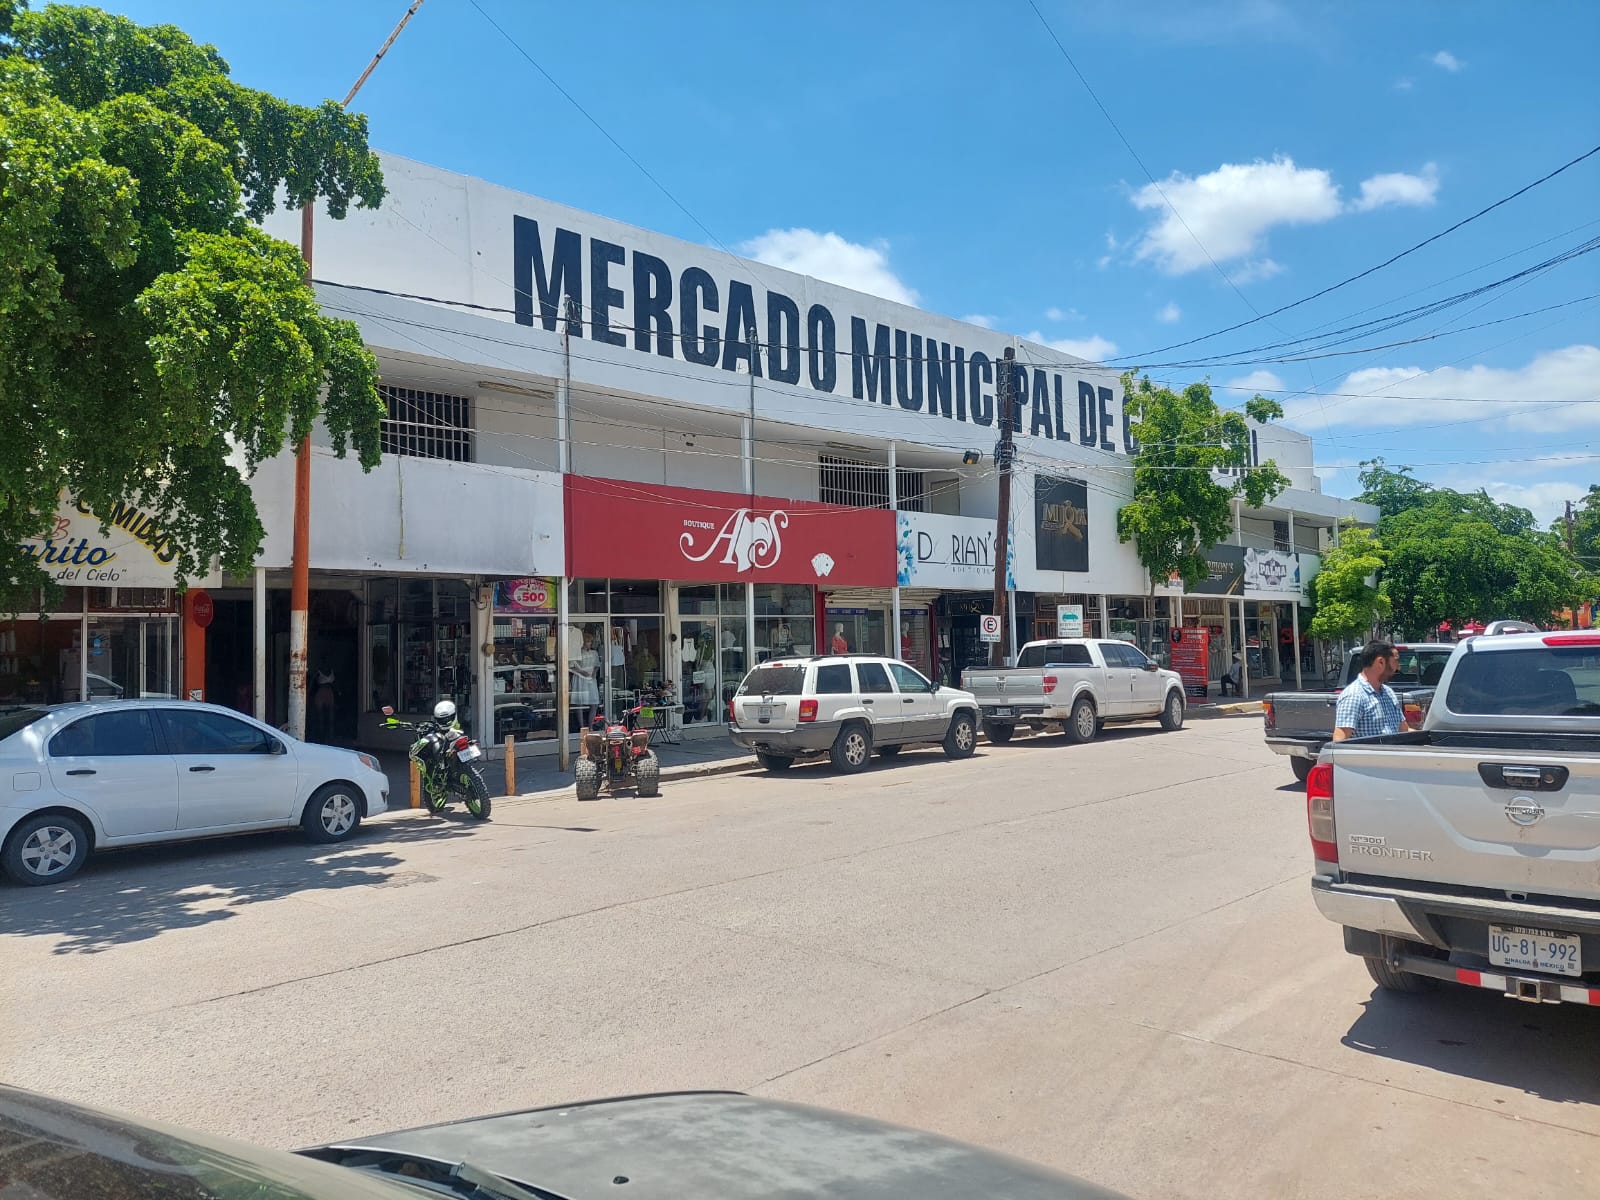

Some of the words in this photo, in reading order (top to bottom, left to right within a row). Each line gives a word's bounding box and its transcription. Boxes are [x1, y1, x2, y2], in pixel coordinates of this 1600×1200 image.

[514, 215, 836, 393] MERCADO
[851, 315, 1070, 442] MUNICIPAL
[1078, 379, 1116, 452] DE
[76, 491, 186, 563] CMIDAS
[683, 519, 715, 530] BOUTIQUE
[18, 538, 117, 566] arito
[918, 531, 998, 566] DRIAN'
[57, 567, 79, 581] del
[1259, 564, 1286, 577] PALMA
[987, 620, 994, 630] E
[1350, 835, 1382, 844] NP300
[1350, 845, 1434, 862] FRONTIER
[1492, 935, 1577, 962] UG-81-992
